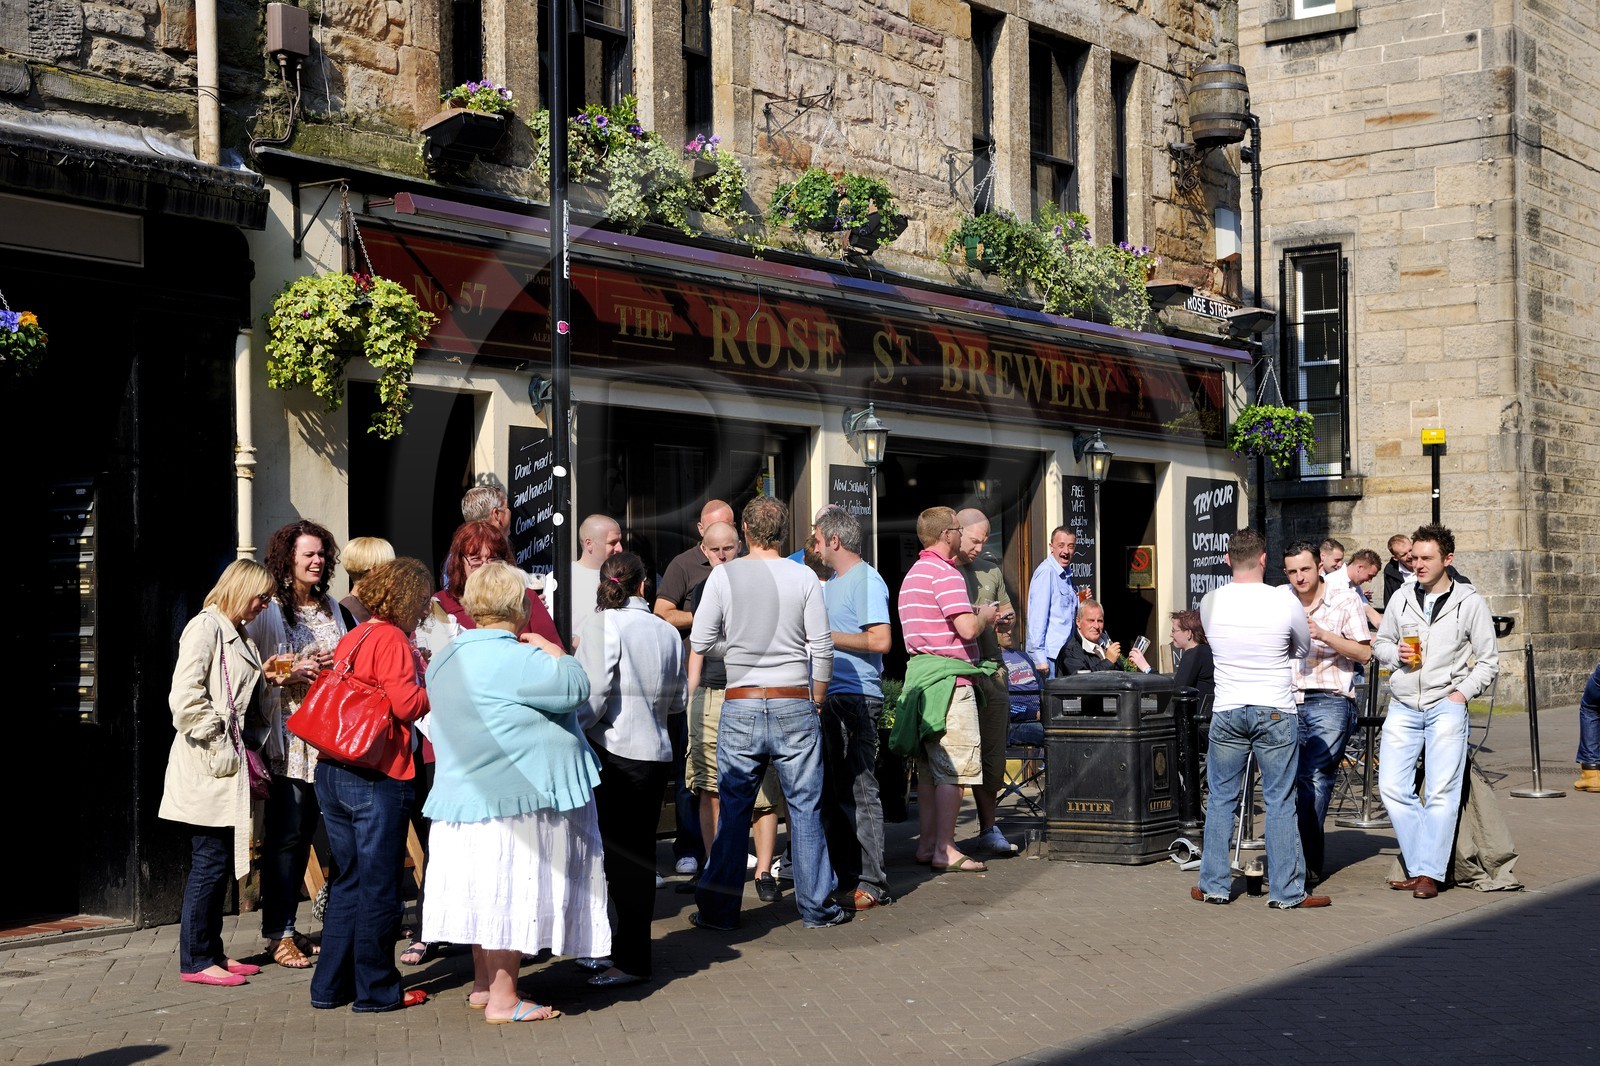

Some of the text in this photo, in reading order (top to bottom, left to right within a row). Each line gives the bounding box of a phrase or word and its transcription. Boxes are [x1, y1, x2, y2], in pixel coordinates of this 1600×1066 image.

[413, 274, 488, 317] No. 57
[1187, 296, 1207, 314] ROSE
[613, 303, 674, 343] THE
[708, 303, 843, 378] ROSE
[939, 340, 1114, 413] BREWERY
[533, 453, 549, 472] read
[513, 485, 529, 509] and
[1070, 484, 1086, 498] FREE
[1193, 484, 1234, 516] TRY OUR
[515, 514, 536, 535] Come
[516, 544, 532, 565] and
[532, 535, 550, 556] have
[1192, 532, 1231, 552] UPSTAIR
[1067, 801, 1111, 813] LITTER
[1149, 799, 1171, 812] LITTER
